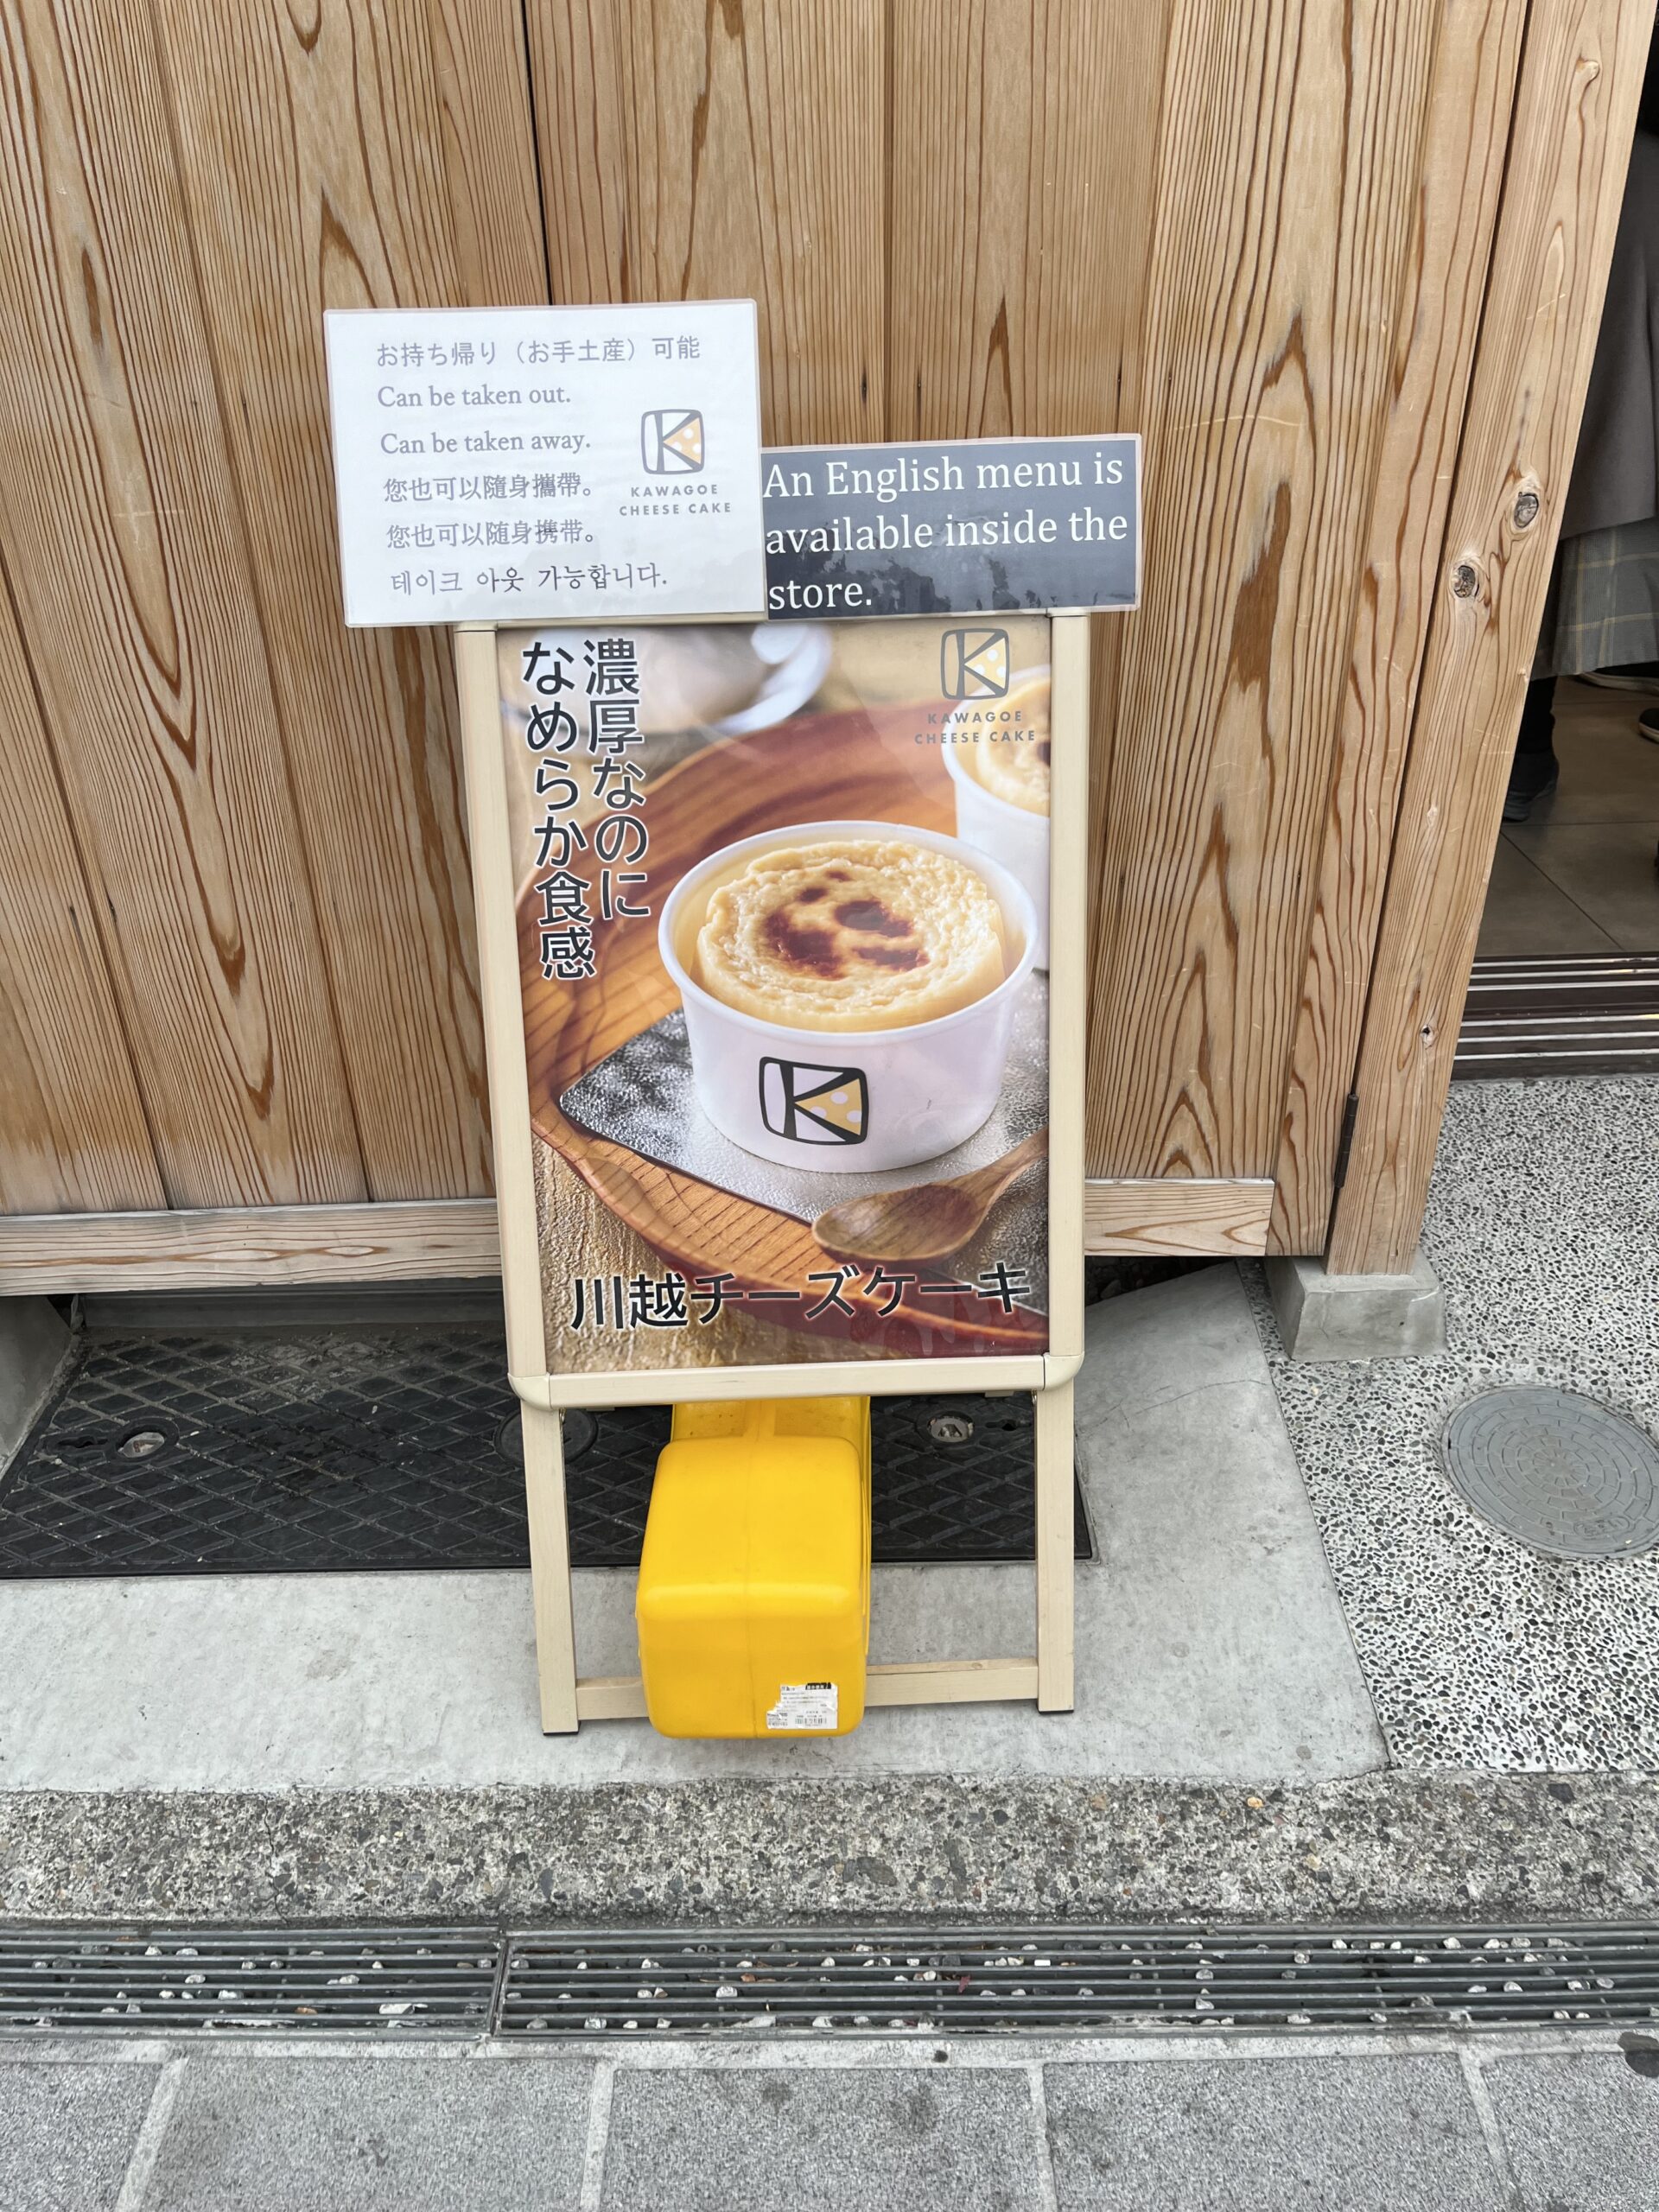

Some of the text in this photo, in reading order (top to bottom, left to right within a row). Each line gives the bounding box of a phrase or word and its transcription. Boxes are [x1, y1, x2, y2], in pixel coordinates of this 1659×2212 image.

[378, 384, 571, 408] Can be taken out.
[380, 430, 591, 454] Can be taken away.
[383, 472, 592, 503] 您也可以隨身攜帶。
[631, 484, 718, 498] KAWAGOE
[763, 452, 1123, 503] An English menu is
[619, 502, 732, 517] CHEESE CAKE
[386, 518, 594, 549] 您也可以随身携带。
[766, 507, 1128, 555] available inside the
[391, 562, 668, 596] 테이크 아웃 가능합니다.
[768, 580, 874, 611] store.
[927, 710, 1022, 725] KAWAGOE
[914, 729, 1036, 745] CHEESE CAKE
[583, 638, 651, 919] 濃厚なのに
[521, 640, 597, 980] なめらか食感
[569, 1261, 1032, 1331] 川越チーズケーキ
